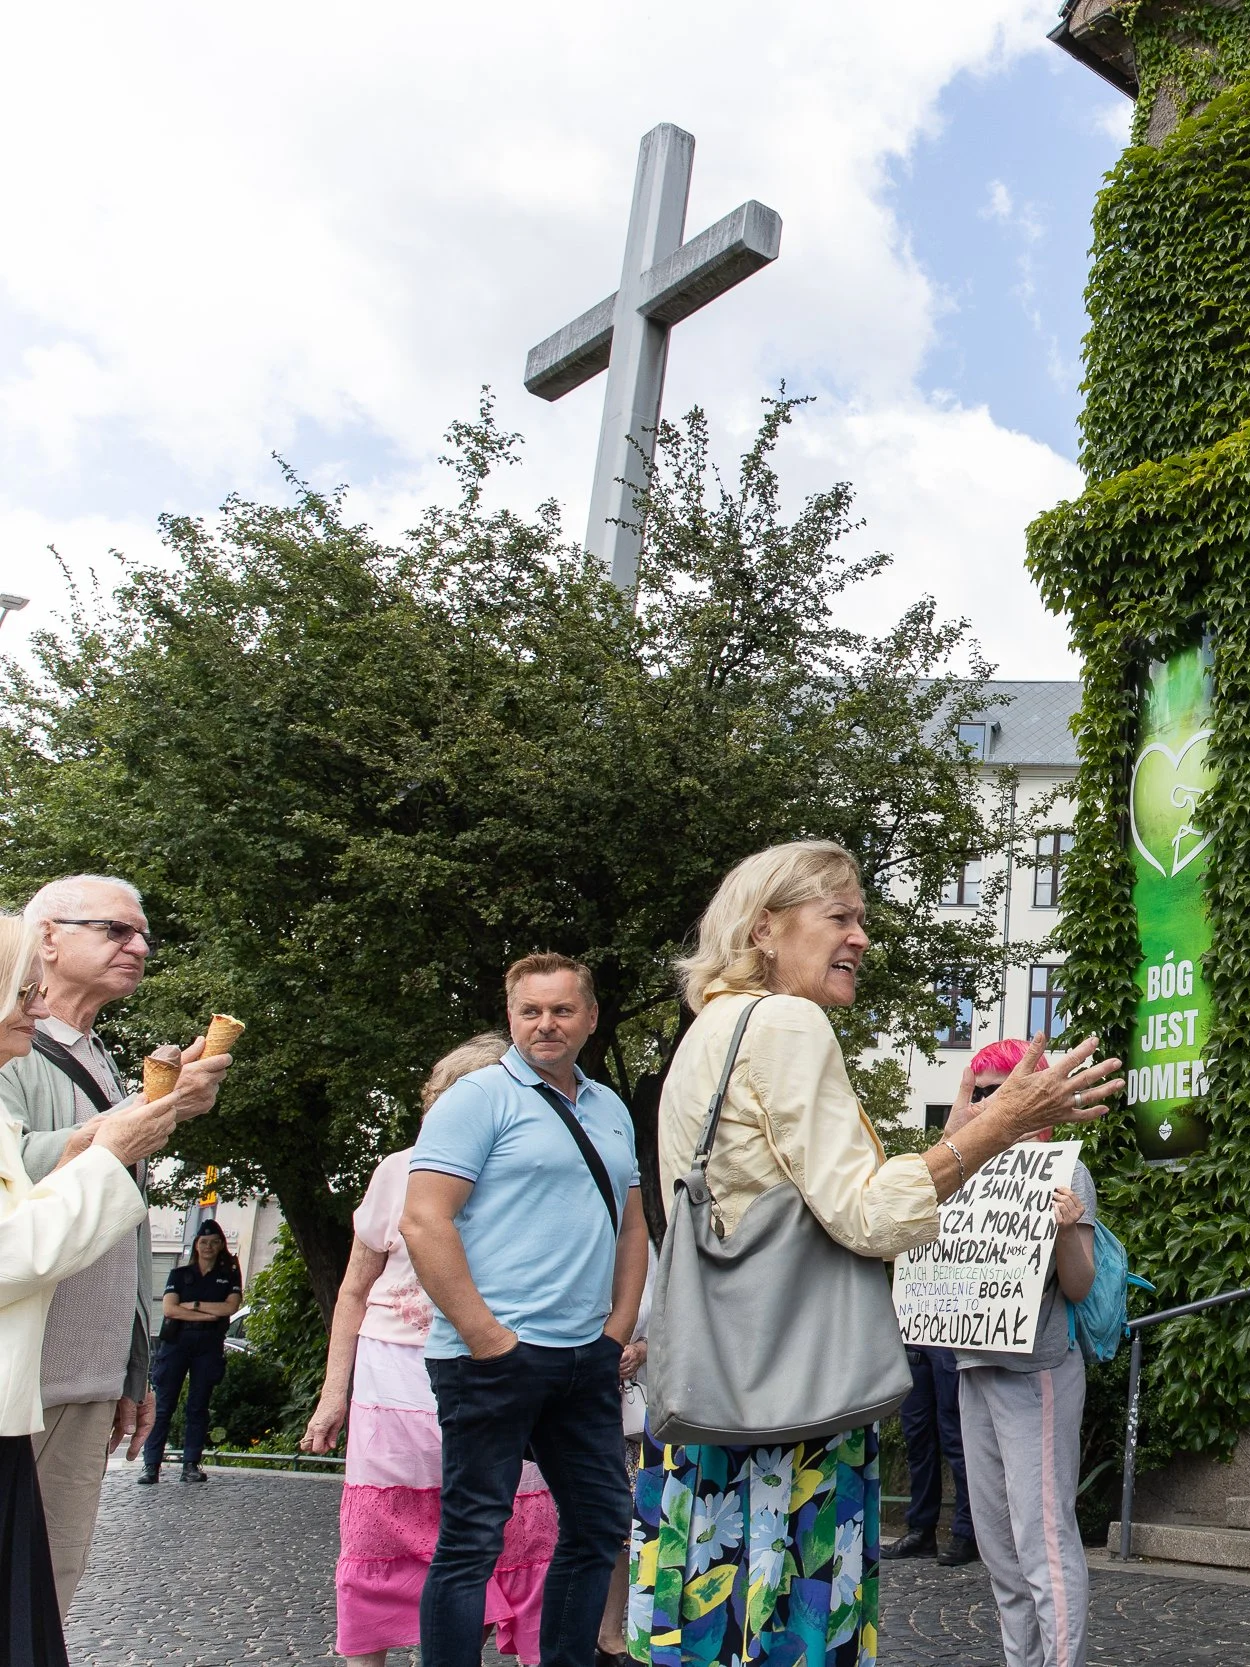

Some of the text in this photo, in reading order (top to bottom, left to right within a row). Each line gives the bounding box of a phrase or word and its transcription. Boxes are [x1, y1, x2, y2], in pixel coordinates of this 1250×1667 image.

[1147, 950, 1194, 1001] BÓG
[1141, 1009, 1199, 1052] JEST
[899, 1267, 912, 1281] ZA
[914, 1264, 927, 1281] ICH
[905, 1280, 1024, 1299] PRZYZWOLENIE BOGA
[899, 1303, 913, 1316] NA
[917, 1299, 930, 1313] ICH
[965, 1299, 979, 1312] TO
